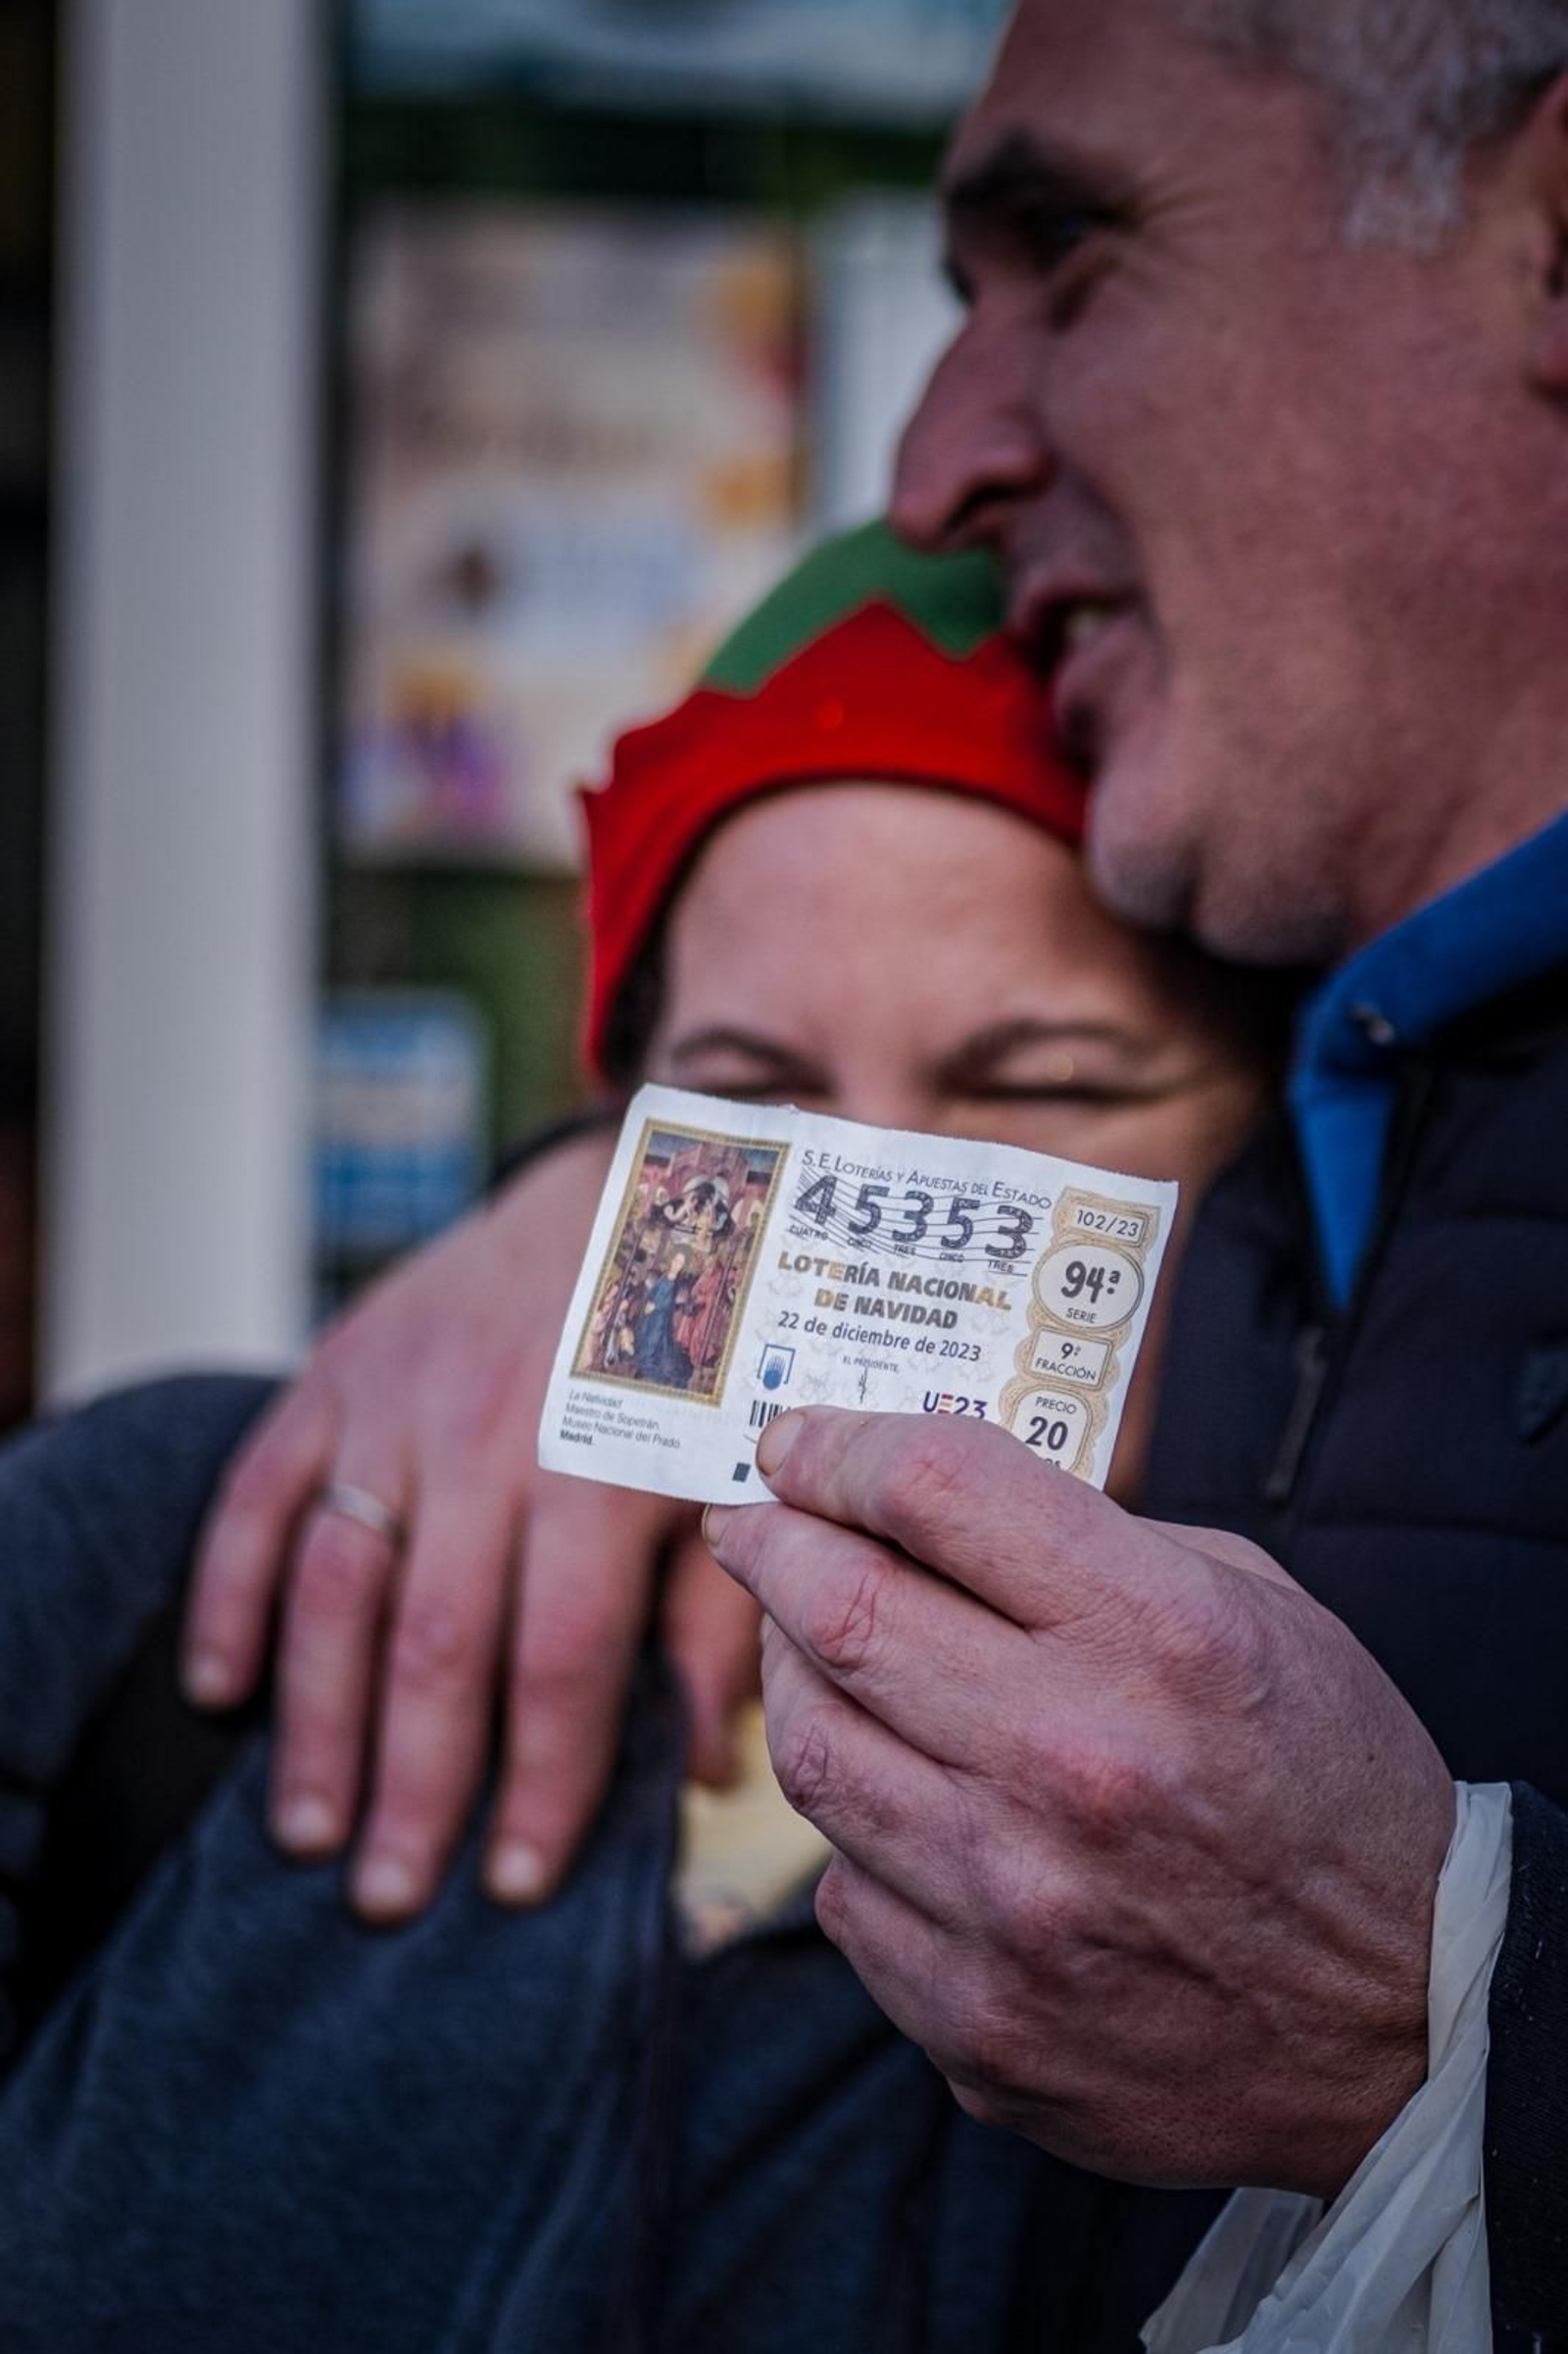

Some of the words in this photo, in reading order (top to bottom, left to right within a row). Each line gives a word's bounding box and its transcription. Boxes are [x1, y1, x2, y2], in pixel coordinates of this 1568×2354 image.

[906, 1170, 968, 1194] APUESTAS
[969, 1182, 990, 1196] DEL
[991, 1180, 1053, 1210] ESTADO
[794, 1174, 1035, 1260] 45353
[1076, 1208, 1140, 1238] 102/23
[778, 1251, 880, 1287] LOTERÍA
[887, 1270, 1013, 1311] NACIONAL
[987, 1259, 1015, 1275] TRES
[813, 1288, 849, 1312] DE
[854, 1296, 959, 1330] NAVIDAD
[1066, 1307, 1098, 1324] SERIE
[777, 1311, 799, 1330] 22
[804, 1315, 828, 1337] de
[832, 1322, 911, 1351] diciembre
[914, 1334, 937, 1356] de
[939, 1339, 983, 1363] 2023
[1035, 1356, 1098, 1381] FRACCIÓN
[1034, 1396, 1078, 1415] PRECIO
[1025, 1416, 1068, 1450] 20
